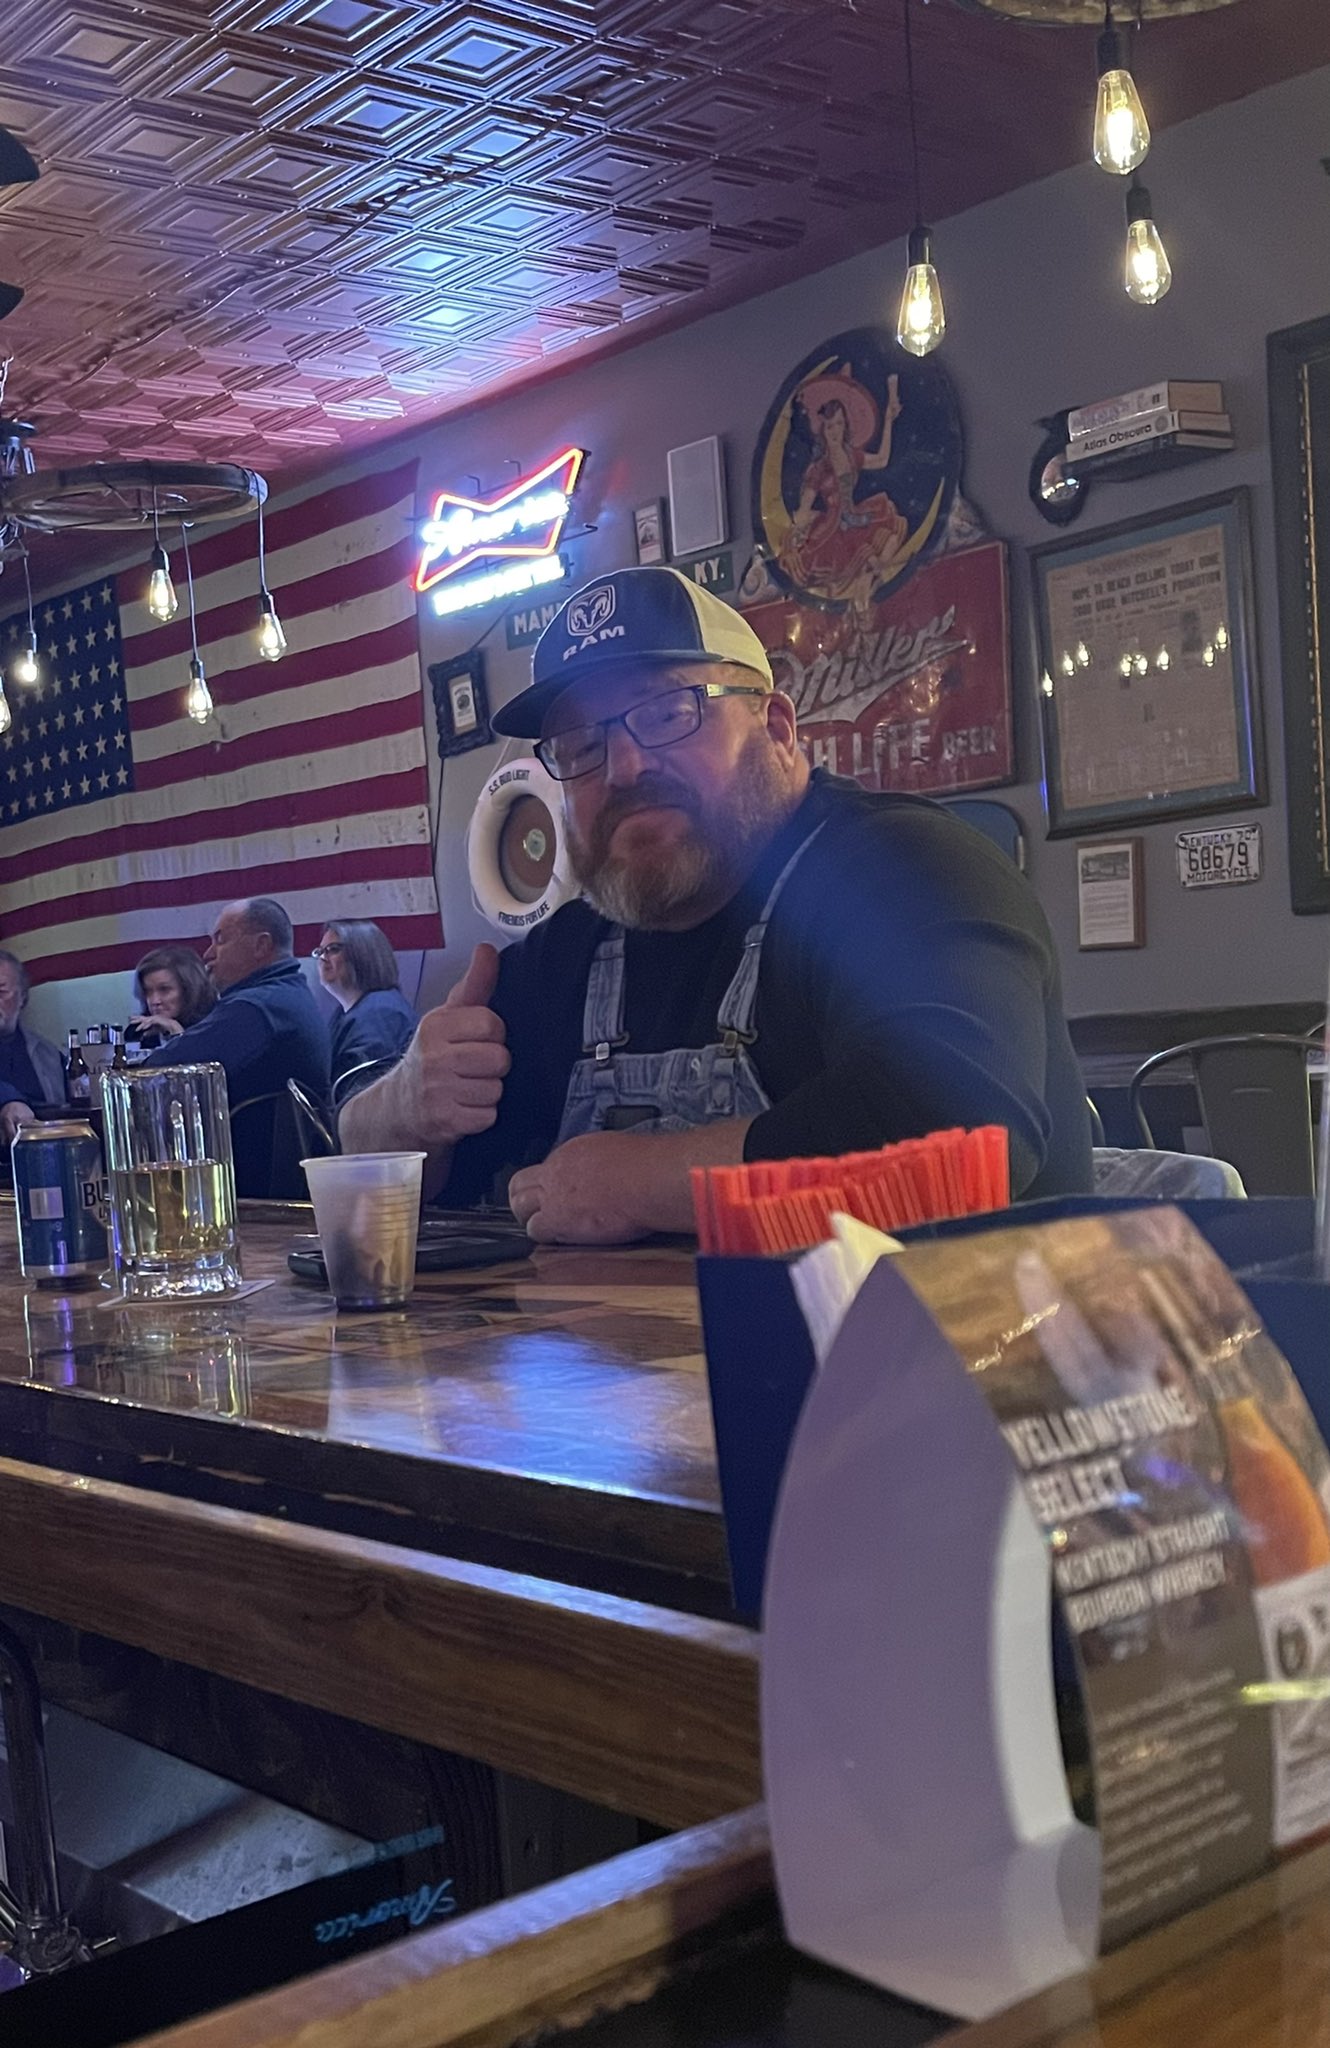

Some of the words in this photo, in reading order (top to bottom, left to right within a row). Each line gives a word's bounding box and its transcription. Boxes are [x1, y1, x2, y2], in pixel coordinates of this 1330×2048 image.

[1084, 436, 1108, 452] Atlas
[1108, 424, 1152, 444] Obscura
[563, 626, 625, 661] RAM
[852, 718, 931, 776] LIFE
[942, 725, 997, 761] BEER
[513, 769, 531, 781] LIGHT
[1184, 833, 1232, 848] KENTUCKY
[1186, 866, 1253, 882] MOTORCYCLE
[498, 911, 525, 927] FRIENDS
[525, 910, 538, 925] FOR
[536, 900, 550, 919] LIFE
[1000, 1386, 1199, 1469] YELLOWSTONE
[1027, 1456, 1130, 1523] SELECT
[1149, 1510, 1230, 1564] STRAIGHT
